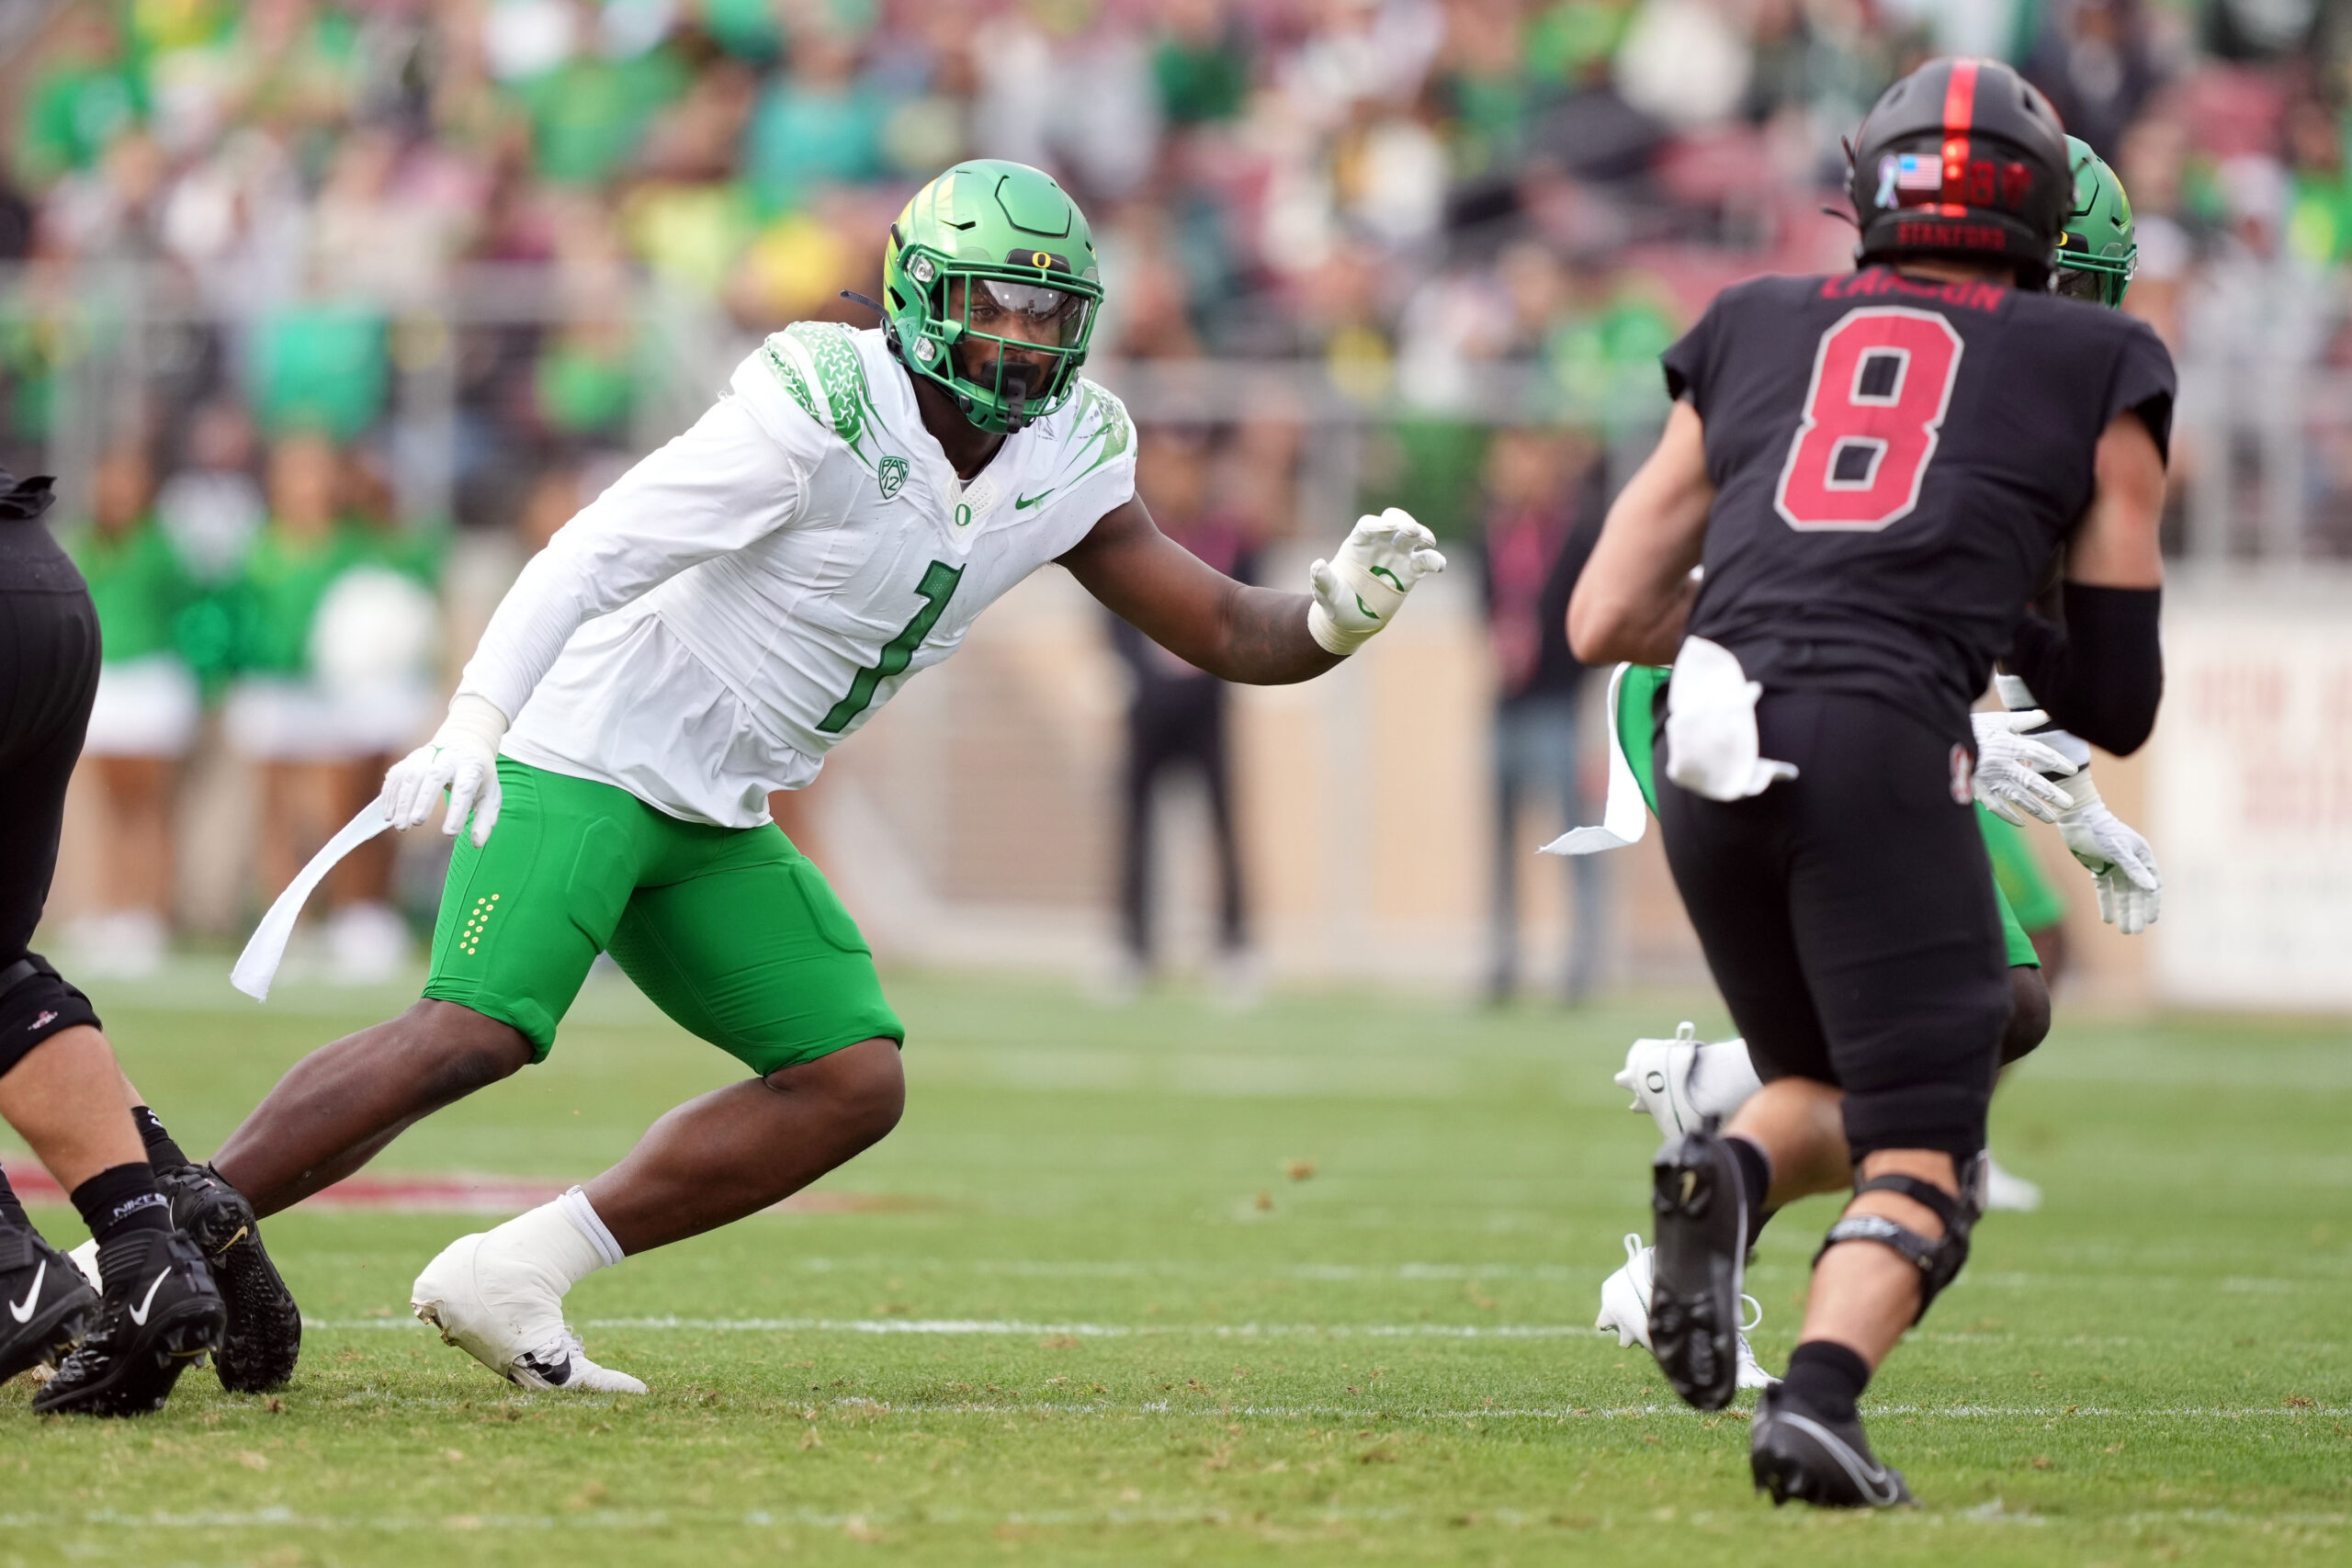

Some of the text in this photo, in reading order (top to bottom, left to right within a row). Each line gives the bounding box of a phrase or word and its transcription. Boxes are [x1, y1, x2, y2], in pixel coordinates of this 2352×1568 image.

[1971, 159, 1996, 207] 8
[1897, 220, 2006, 251] STANFORD
[1032, 252, 1051, 268] O
[1773, 305, 1964, 532] 8
[882, 459, 908, 482] PAC
[883, 476, 899, 491] 12
[955, 503, 971, 526] O
[815, 559, 967, 733] 1
[113, 1193, 153, 1218] NIKE
